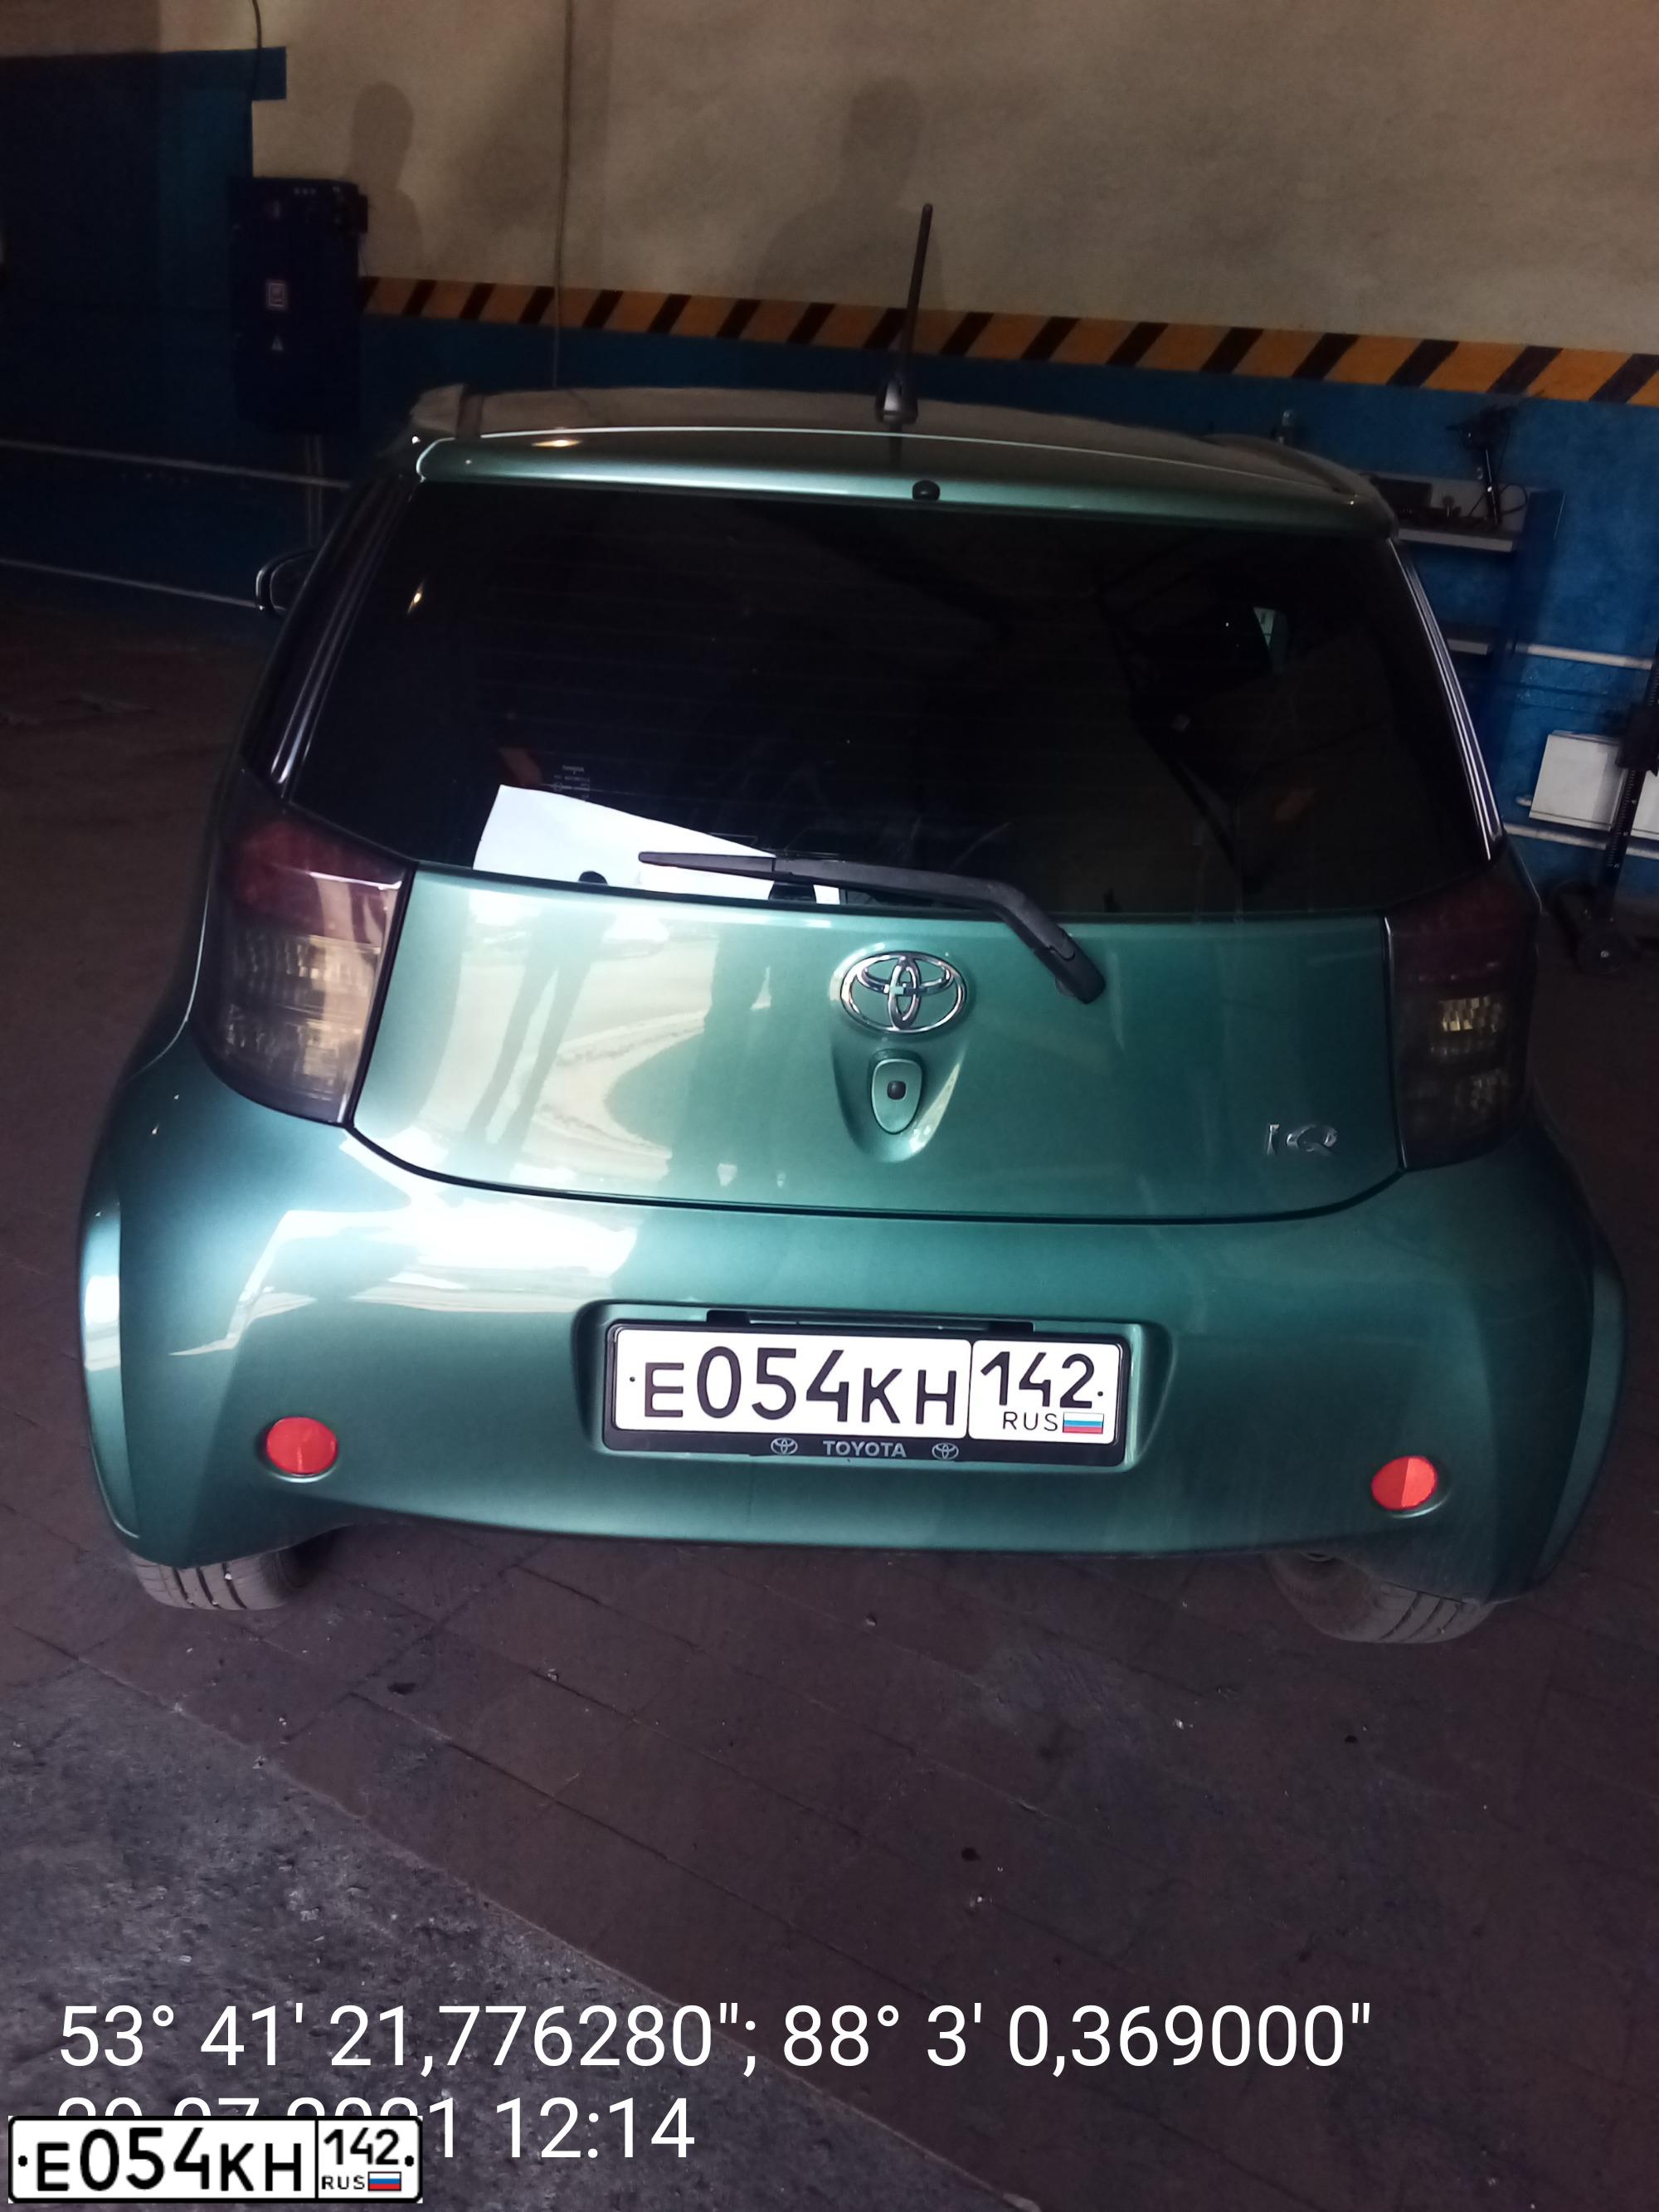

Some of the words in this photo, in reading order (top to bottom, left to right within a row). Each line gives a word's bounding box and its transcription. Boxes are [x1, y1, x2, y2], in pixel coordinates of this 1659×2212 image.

[980, 1351, 1095, 1409] 142
[1002, 1411, 1058, 1432] RUS
[822, 1440, 907, 1458] TOYOTA
